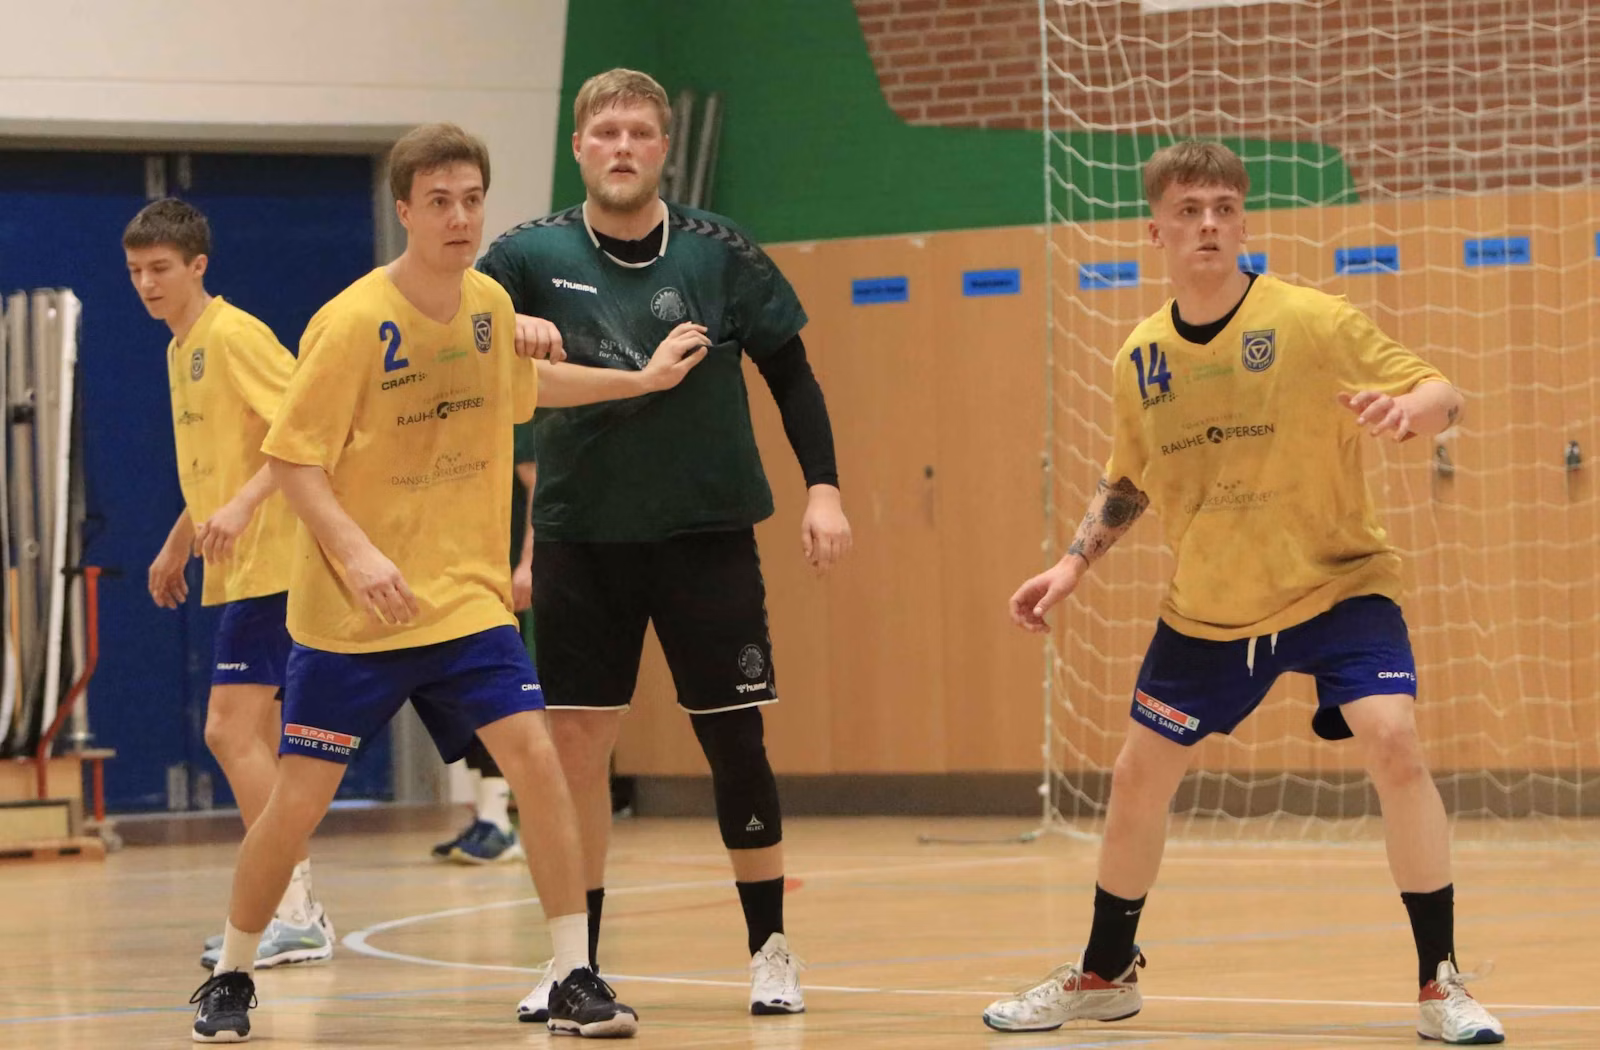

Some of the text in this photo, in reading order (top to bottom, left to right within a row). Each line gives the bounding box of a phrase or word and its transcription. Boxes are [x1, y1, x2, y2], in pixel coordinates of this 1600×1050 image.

[563, 279, 598, 295] hummel
[379, 320, 410, 373] 2
[1129, 342, 1172, 400] 14
[381, 374, 417, 391] CRAFT
[1161, 434, 1206, 456] RAUHE
[1377, 671, 1410, 679] CRAFT
[521, 683, 542, 691] CRAF
[1146, 699, 1171, 716] SPAR
[1137, 704, 1185, 736] HVIDE SANDE
[301, 728, 335, 741] SPAR
[288, 736, 351, 756] HVIDE SANDE
